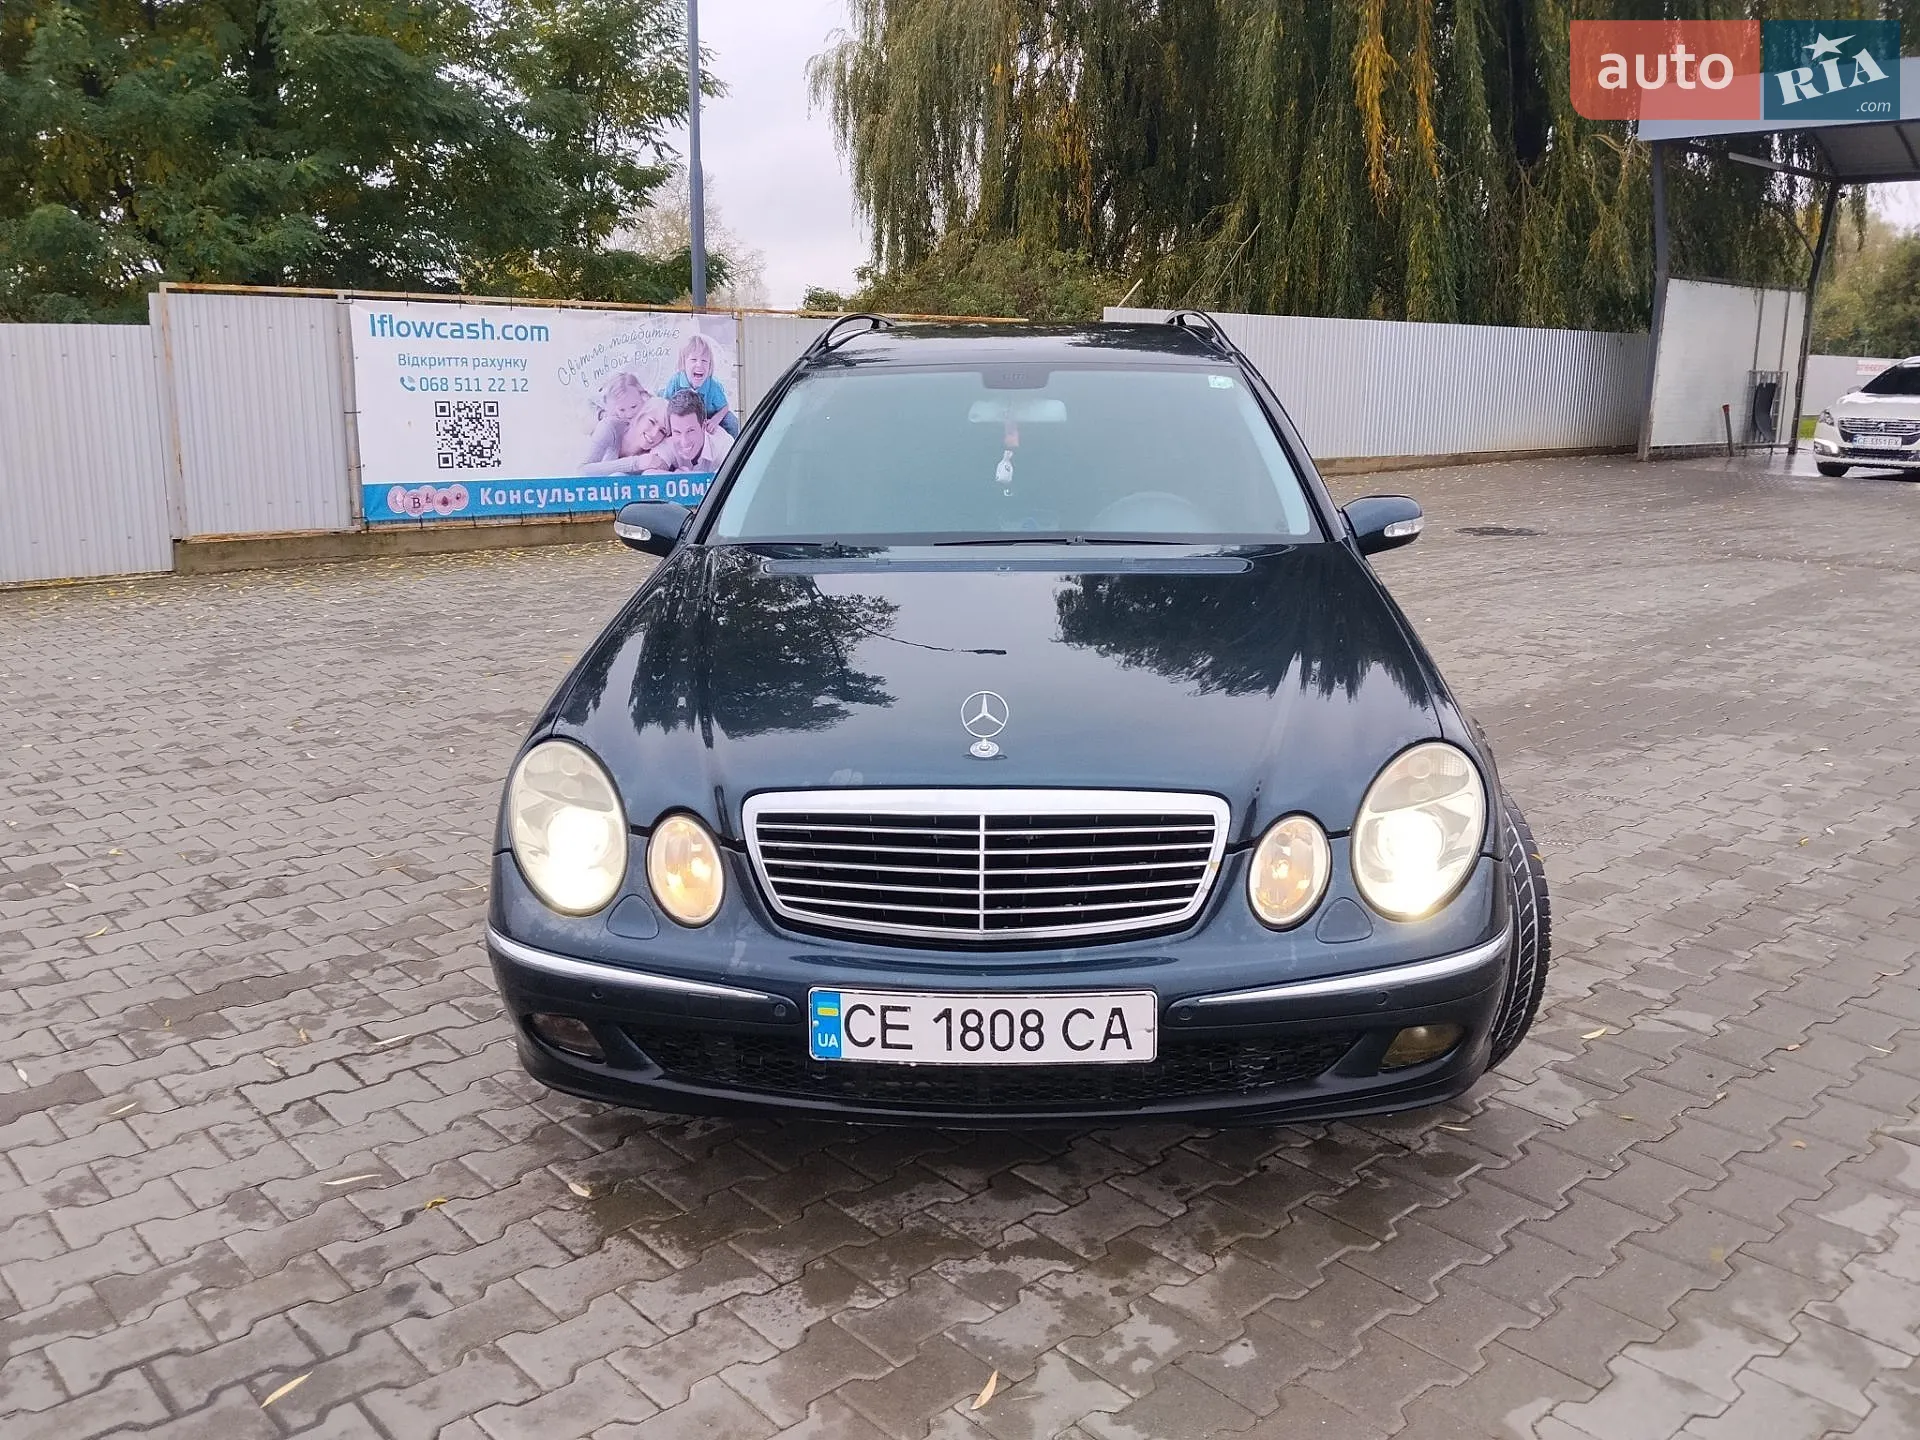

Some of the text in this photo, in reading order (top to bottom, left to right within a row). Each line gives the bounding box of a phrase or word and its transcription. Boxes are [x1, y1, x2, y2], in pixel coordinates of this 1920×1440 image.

[398, 353, 528, 371] Відкриття рахунку
[419, 377, 529, 392] 068 511 22 12
[480, 483, 632, 509] Консультація
[637, 485, 660, 499] та
[844, 1004, 1133, 1052] CE 1808 CA
[817, 1033, 839, 1048] UA
